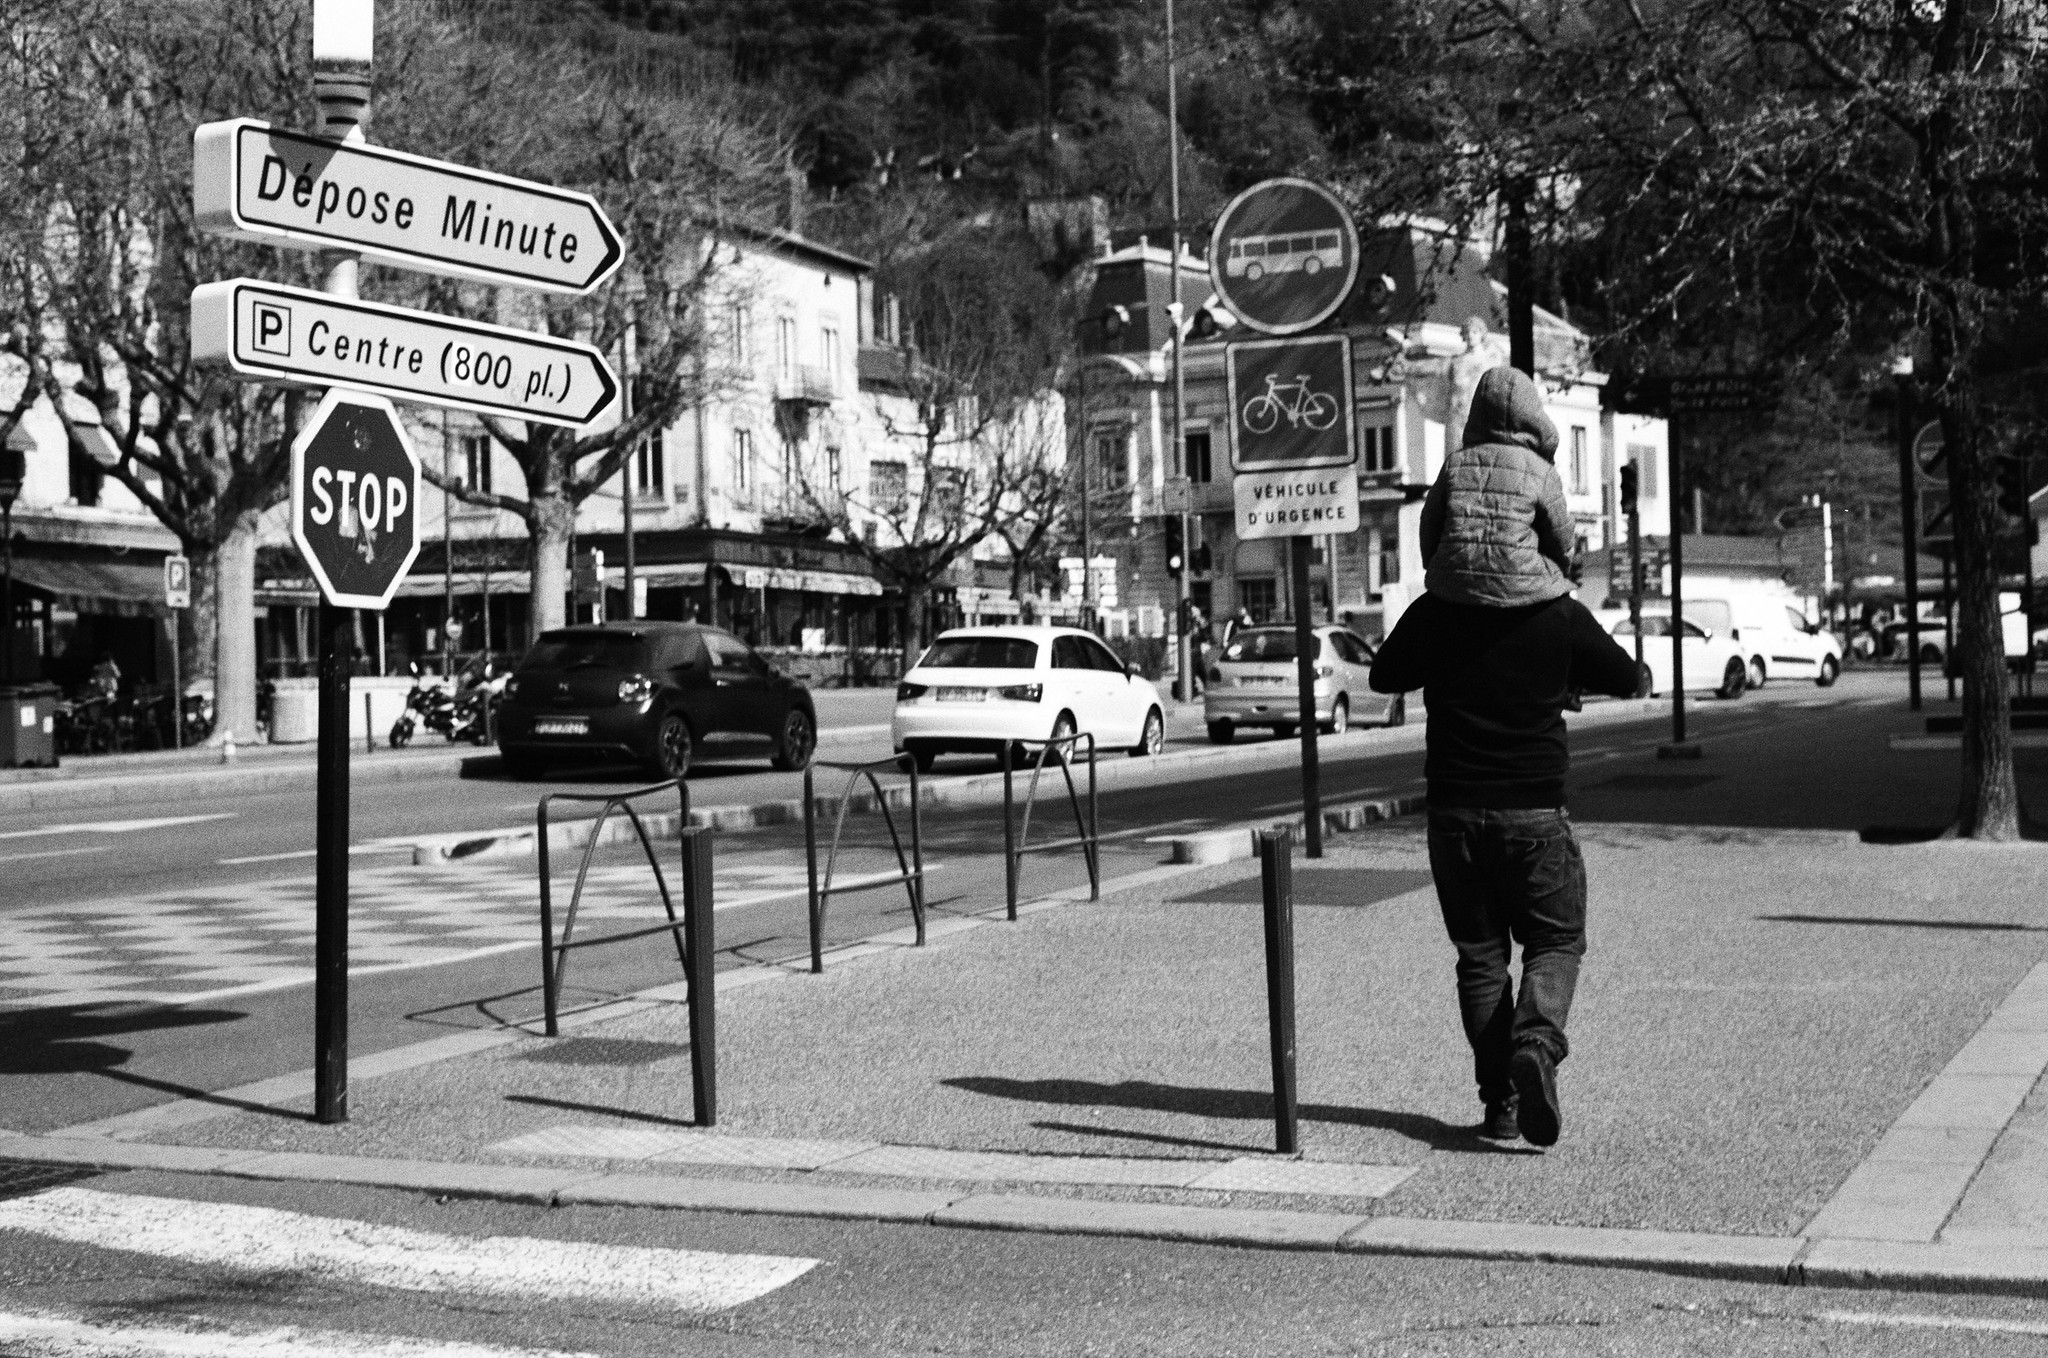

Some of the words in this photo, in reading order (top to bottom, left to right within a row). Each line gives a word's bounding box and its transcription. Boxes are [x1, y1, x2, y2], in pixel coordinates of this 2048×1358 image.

[257, 154, 415, 229] Dépose
[441, 194, 578, 264] Minute
[260, 309, 284, 345] P
[308, 319, 424, 374] Centre
[440, 341, 512, 389] (800
[524, 362, 572, 404] pl.)
[310, 465, 408, 533] STOP
[1248, 505, 1346, 525] D'URGENCE
[172, 563, 183, 588] P
